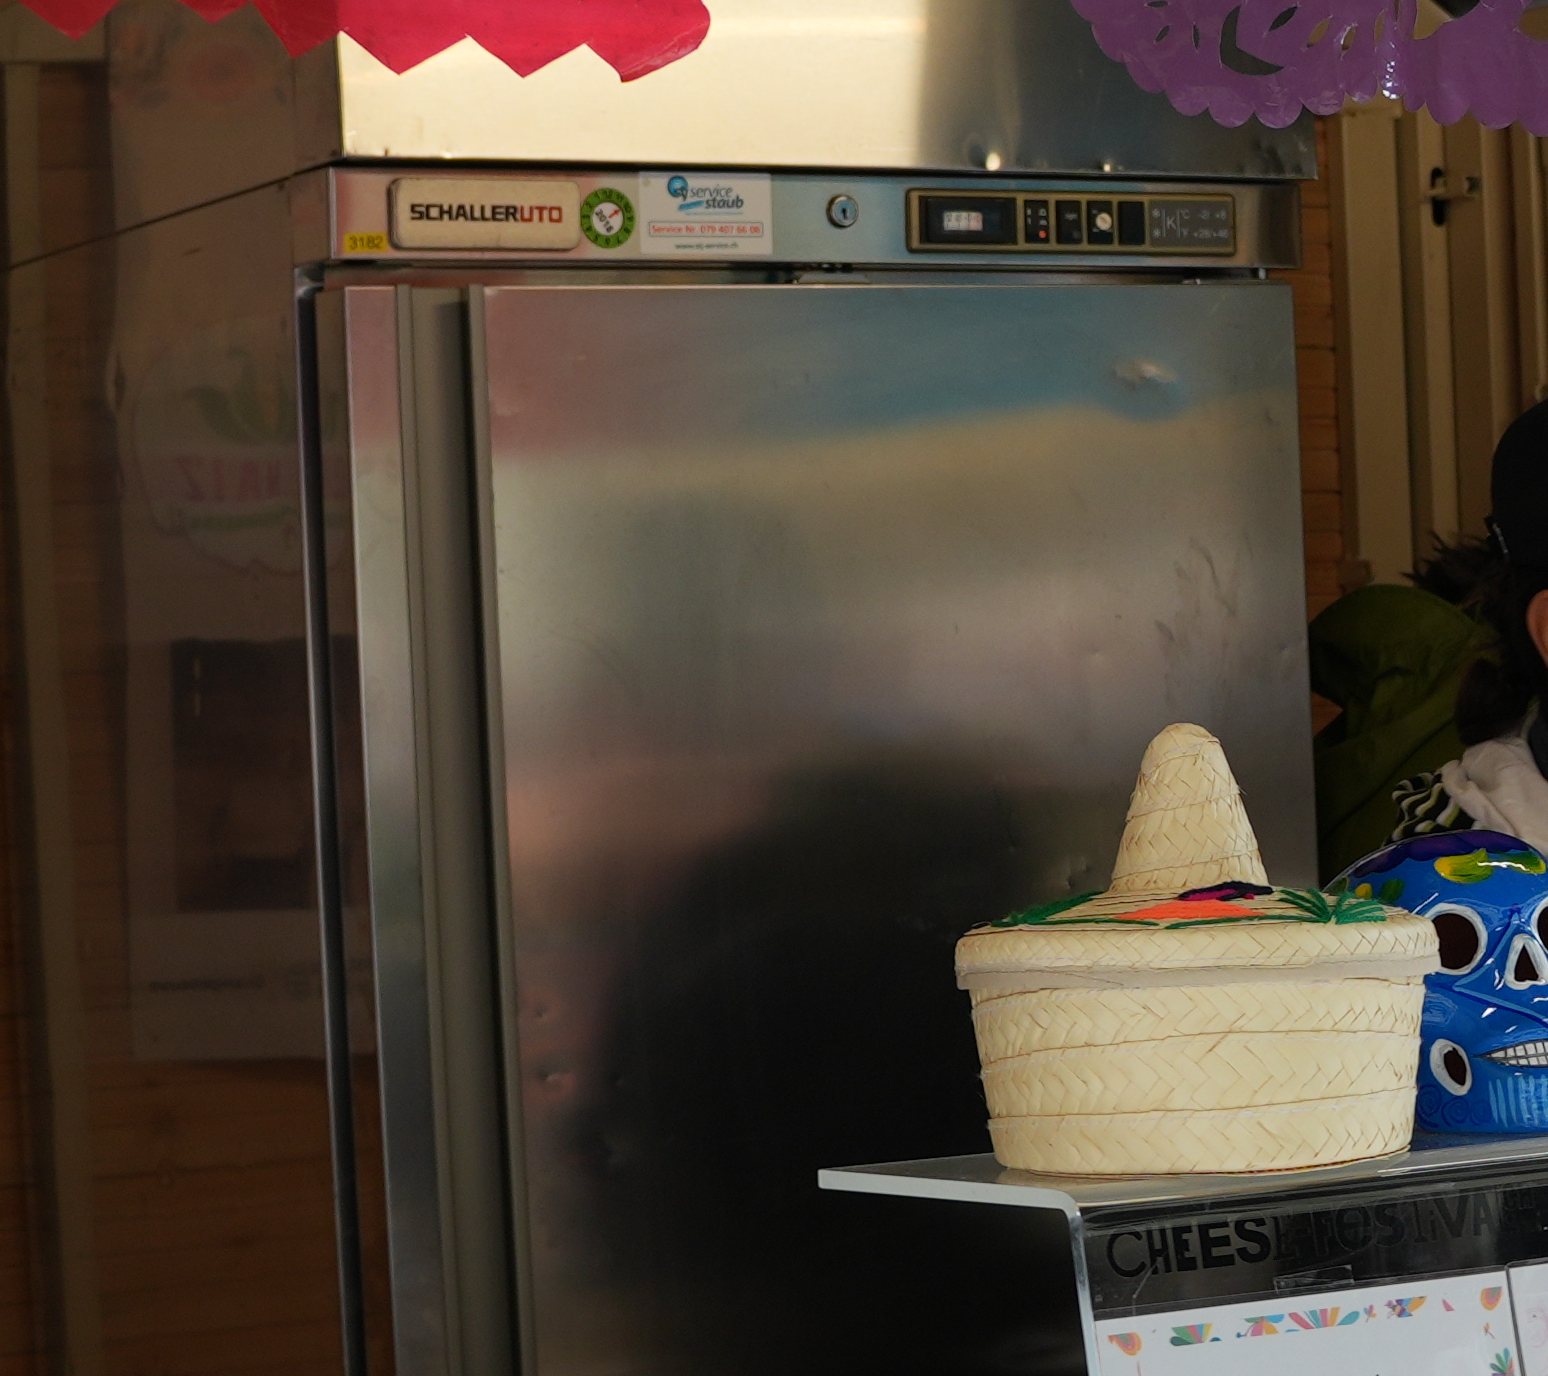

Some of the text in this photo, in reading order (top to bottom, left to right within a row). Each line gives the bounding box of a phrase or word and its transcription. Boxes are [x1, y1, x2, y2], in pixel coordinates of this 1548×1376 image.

[690, 184, 733, 199] service
[704, 195, 744, 210] staub
[409, 203, 563, 224] SCHALLERUTO
[348, 235, 384, 251] 3182
